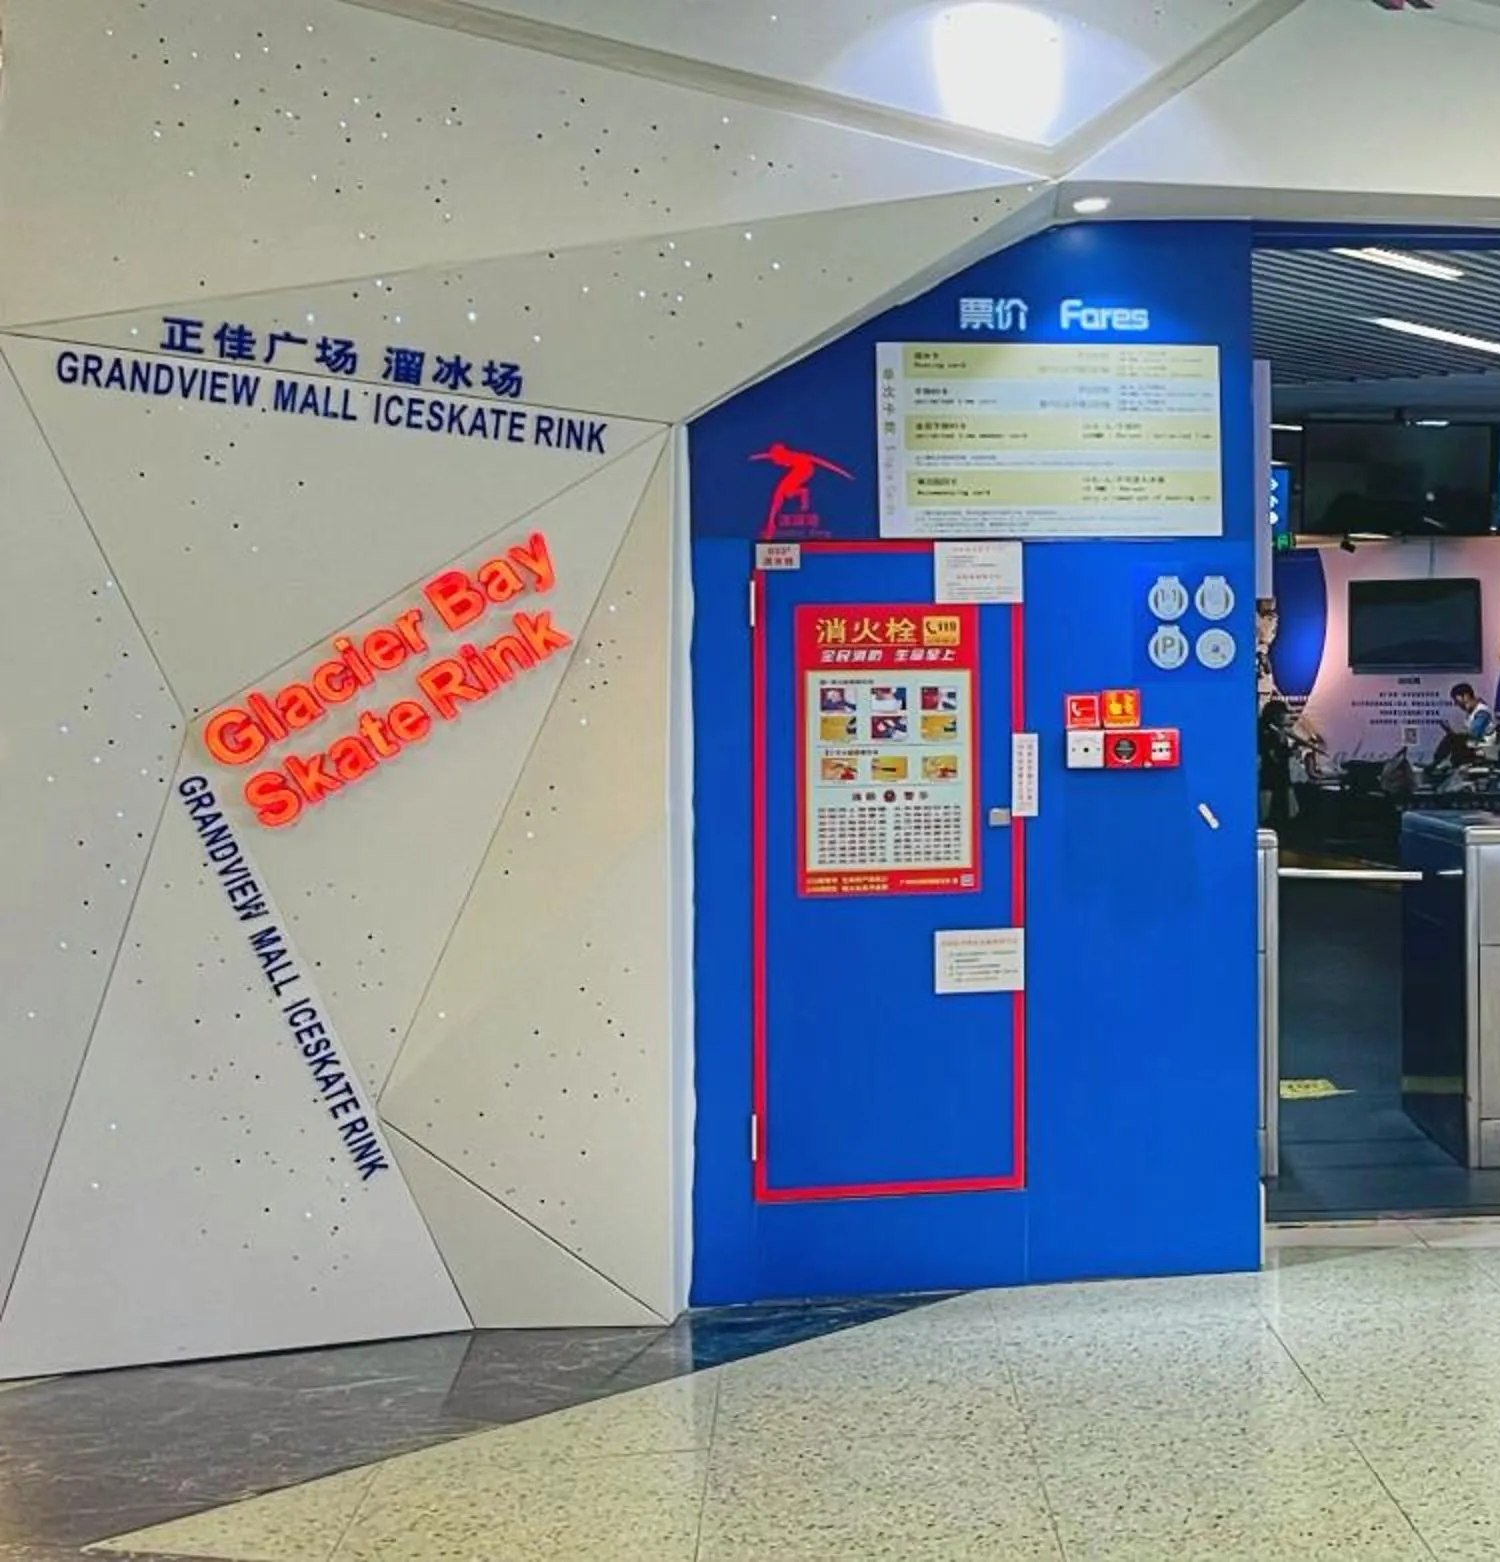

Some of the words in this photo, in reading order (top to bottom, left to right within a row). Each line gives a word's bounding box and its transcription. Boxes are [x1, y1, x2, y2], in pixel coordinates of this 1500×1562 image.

[159, 315, 358, 375] 正佳广场
[383, 345, 525, 399] 溜冰场
[959, 297, 1028, 331] 票价
[1060, 299, 1150, 331] Fares
[56, 350, 260, 408] GRANDVIEW
[273, 380, 358, 422] MALL
[373, 391, 525, 443] ICESKATE
[534, 416, 608, 455] RINK
[203, 607, 425, 767] Glacier
[425, 530, 556, 631] Bay
[815, 617, 918, 645] 消火栓
[243, 698, 432, 828] Skate
[417, 610, 572, 721] Rink
[178, 774, 270, 922] GRANDVIEW
[248, 925, 301, 997] MALL
[283, 996, 361, 1120] ICESKATE
[338, 1116, 389, 1182] RINK
